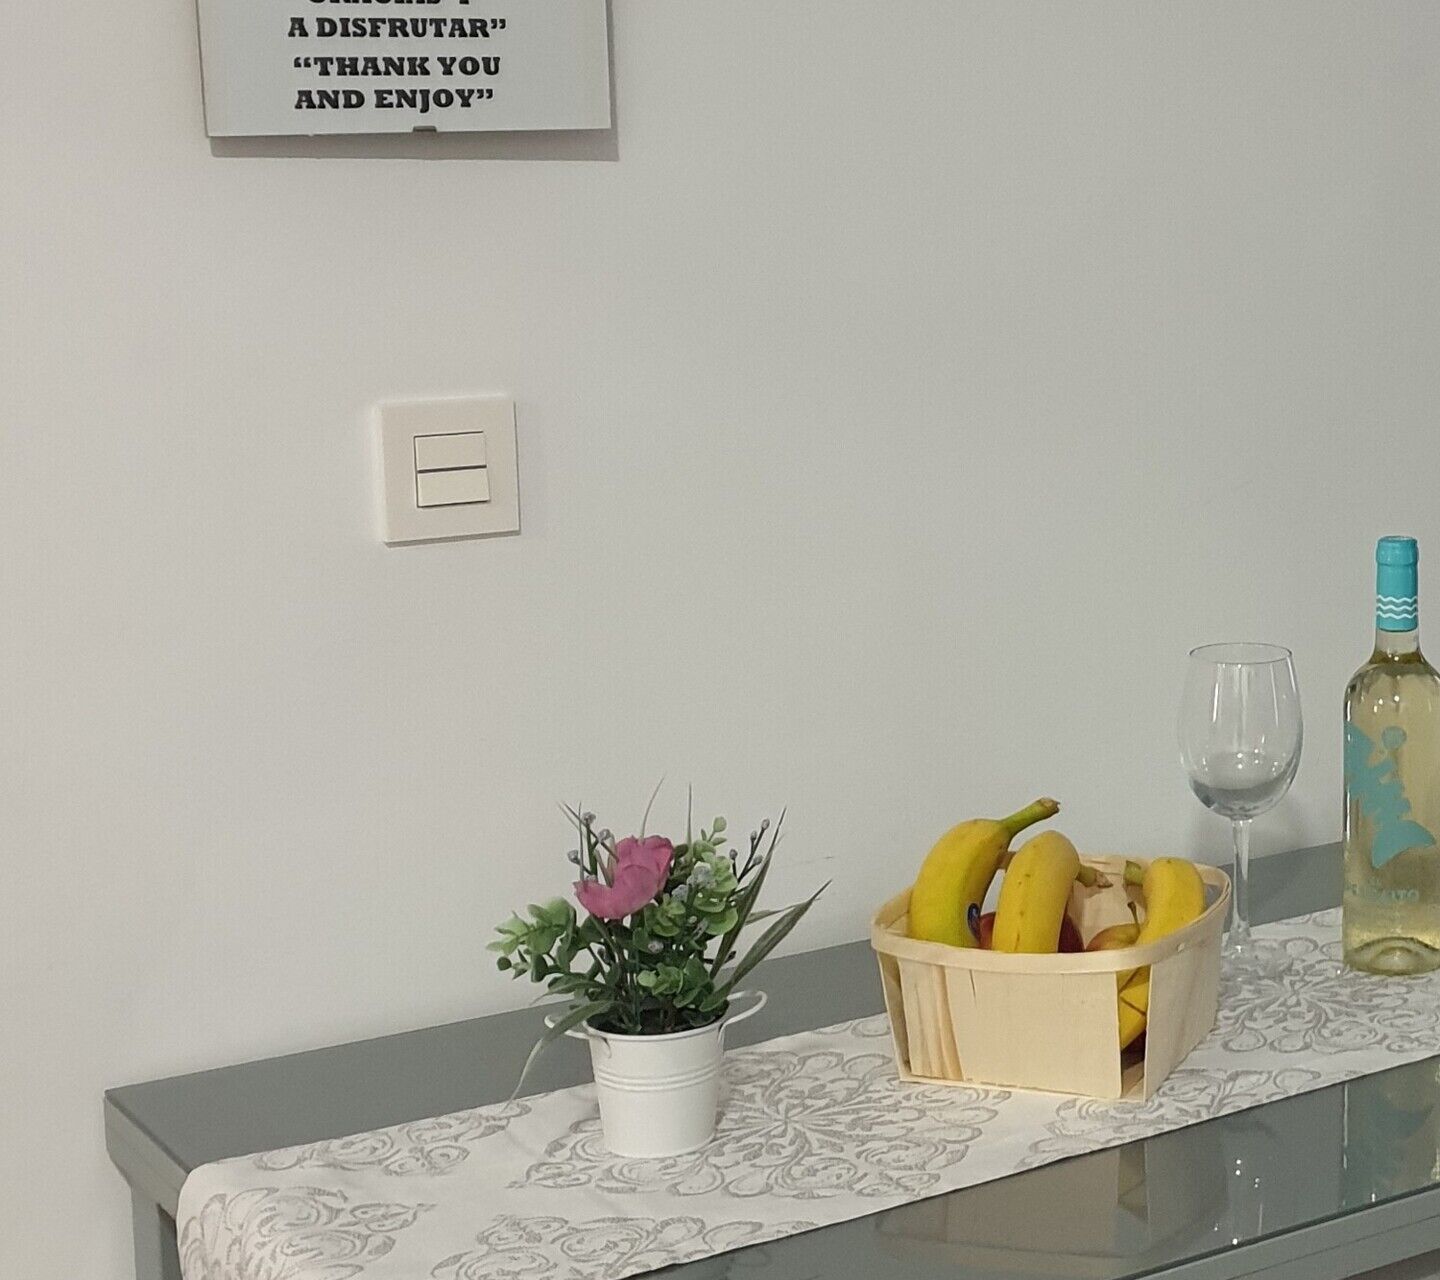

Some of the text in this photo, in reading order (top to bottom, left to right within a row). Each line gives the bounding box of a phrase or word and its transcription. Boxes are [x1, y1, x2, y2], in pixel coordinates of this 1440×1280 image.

[287, 16, 507, 39] A DISFRUTAR”
[293, 56, 501, 77] “THANK YOU
[294, 88, 494, 114] AND ENJOY”
